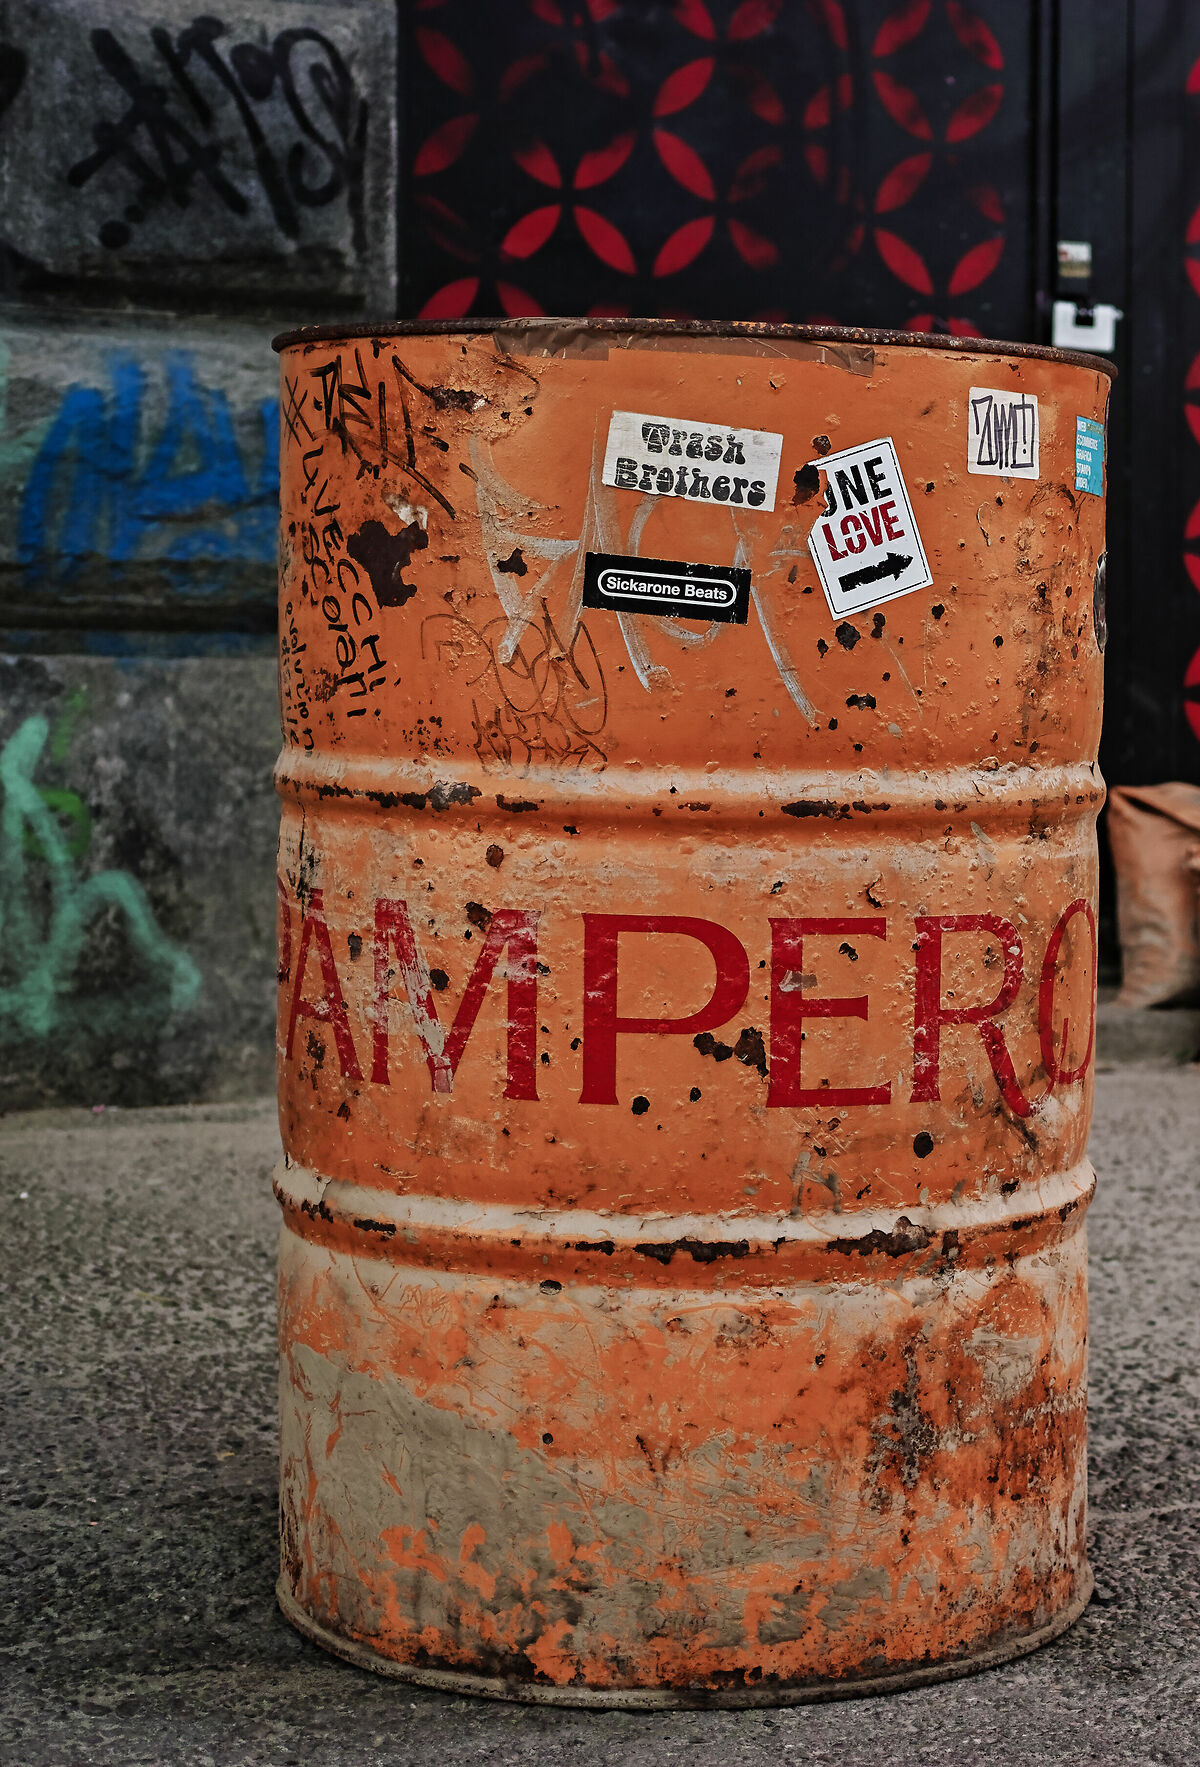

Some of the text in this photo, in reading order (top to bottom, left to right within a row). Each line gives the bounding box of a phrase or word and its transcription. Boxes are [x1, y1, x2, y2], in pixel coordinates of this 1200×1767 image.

[641, 421, 746, 465] Trash
[614, 456, 767, 506] Brothers
[821, 500, 905, 562] LOVE
[605, 576, 728, 601] Sickarone Beats
